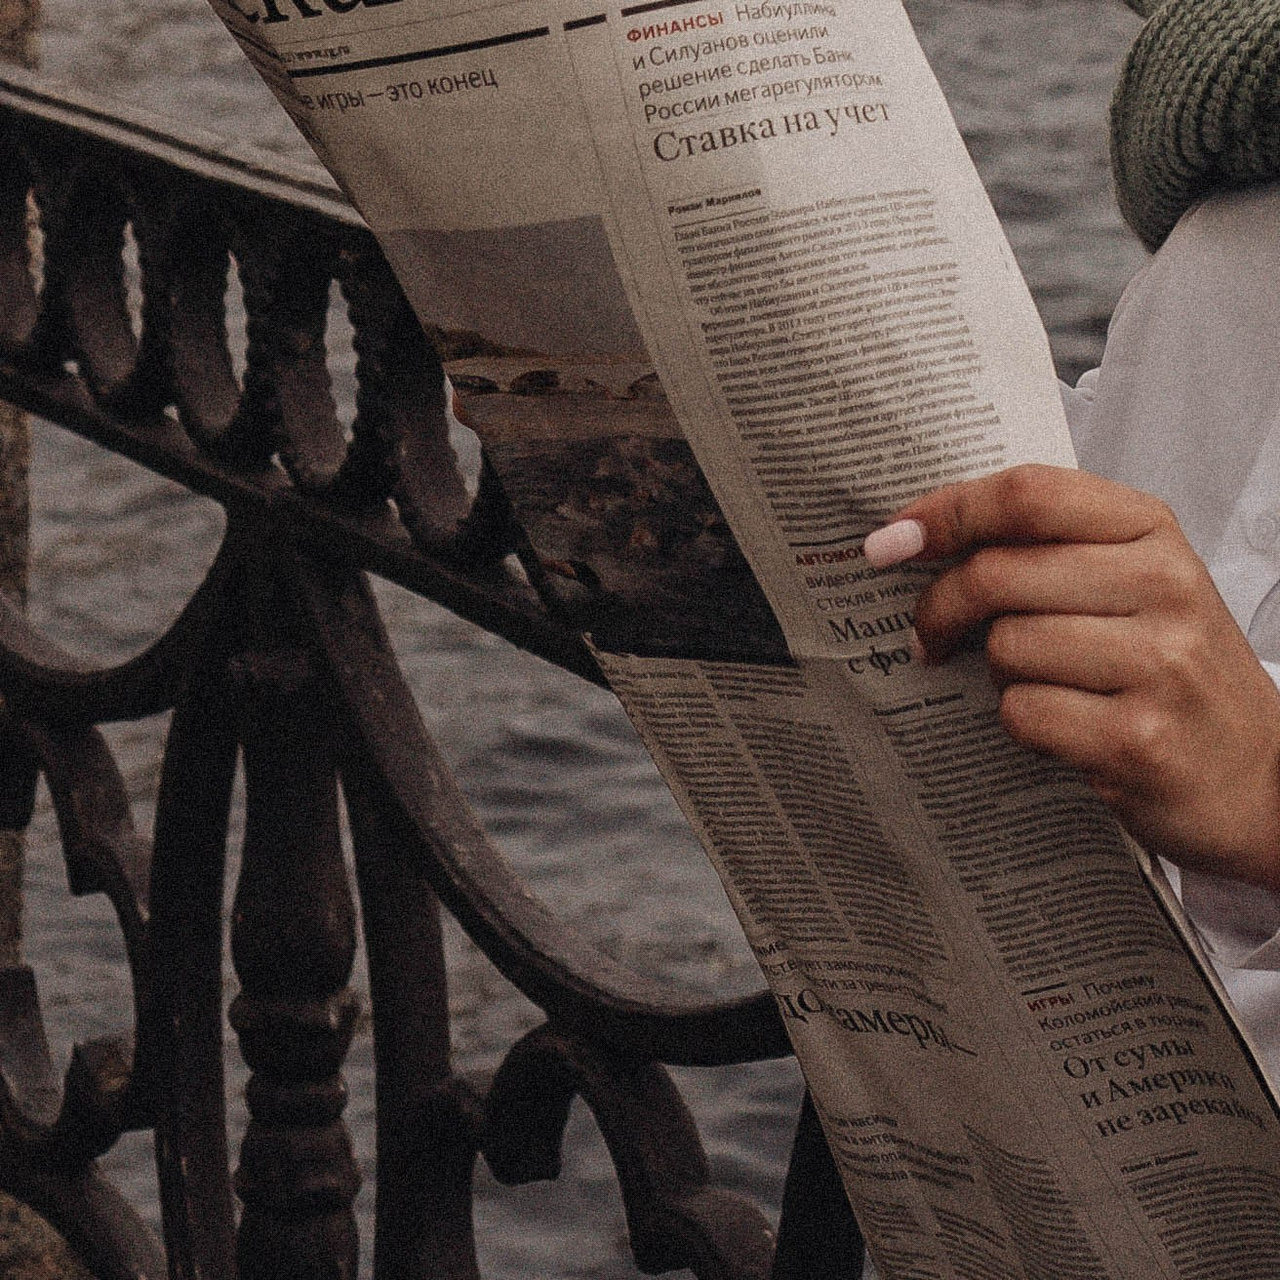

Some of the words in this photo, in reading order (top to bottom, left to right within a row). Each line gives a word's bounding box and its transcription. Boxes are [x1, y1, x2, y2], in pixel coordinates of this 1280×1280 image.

[625, 10, 725, 43] ФИНАНСЫ
[735, 0, 838, 24] Набиуллина
[631, 55, 646, 71] и
[649, 32, 750, 67] Силуанов
[752, 24, 829, 47] оценили
[317, 89, 366, 115] игры
[387, 81, 423, 102] это
[427, 68, 499, 97] конец
[637, 63, 733, 102] решение
[735, 52, 812, 77] сделать
[643, 94, 721, 124] России
[724, 72, 883, 107] мегарегулятором
[653, 115, 777, 163] Ставка
[781, 108, 821, 135] на
[824, 101, 891, 137] учет
[816, 590, 876, 612] стекле
[847, 656, 866, 675] с
[868, 645, 912, 676] фо
[1026, 992, 1076, 1014] ИГРЫ
[1081, 973, 1156, 1000] Почему
[1036, 992, 1166, 1034] Коломойский
[828, 1007, 956, 1054] амеры
[1048, 1019, 1133, 1053] остаться
[1134, 1017, 1147, 1030] в
[1062, 1054, 1107, 1080] От
[1113, 1038, 1197, 1071] сумы
[1078, 1089, 1104, 1111] и
[1106, 1068, 1237, 1103] Америки
[1094, 1113, 1133, 1139] не
